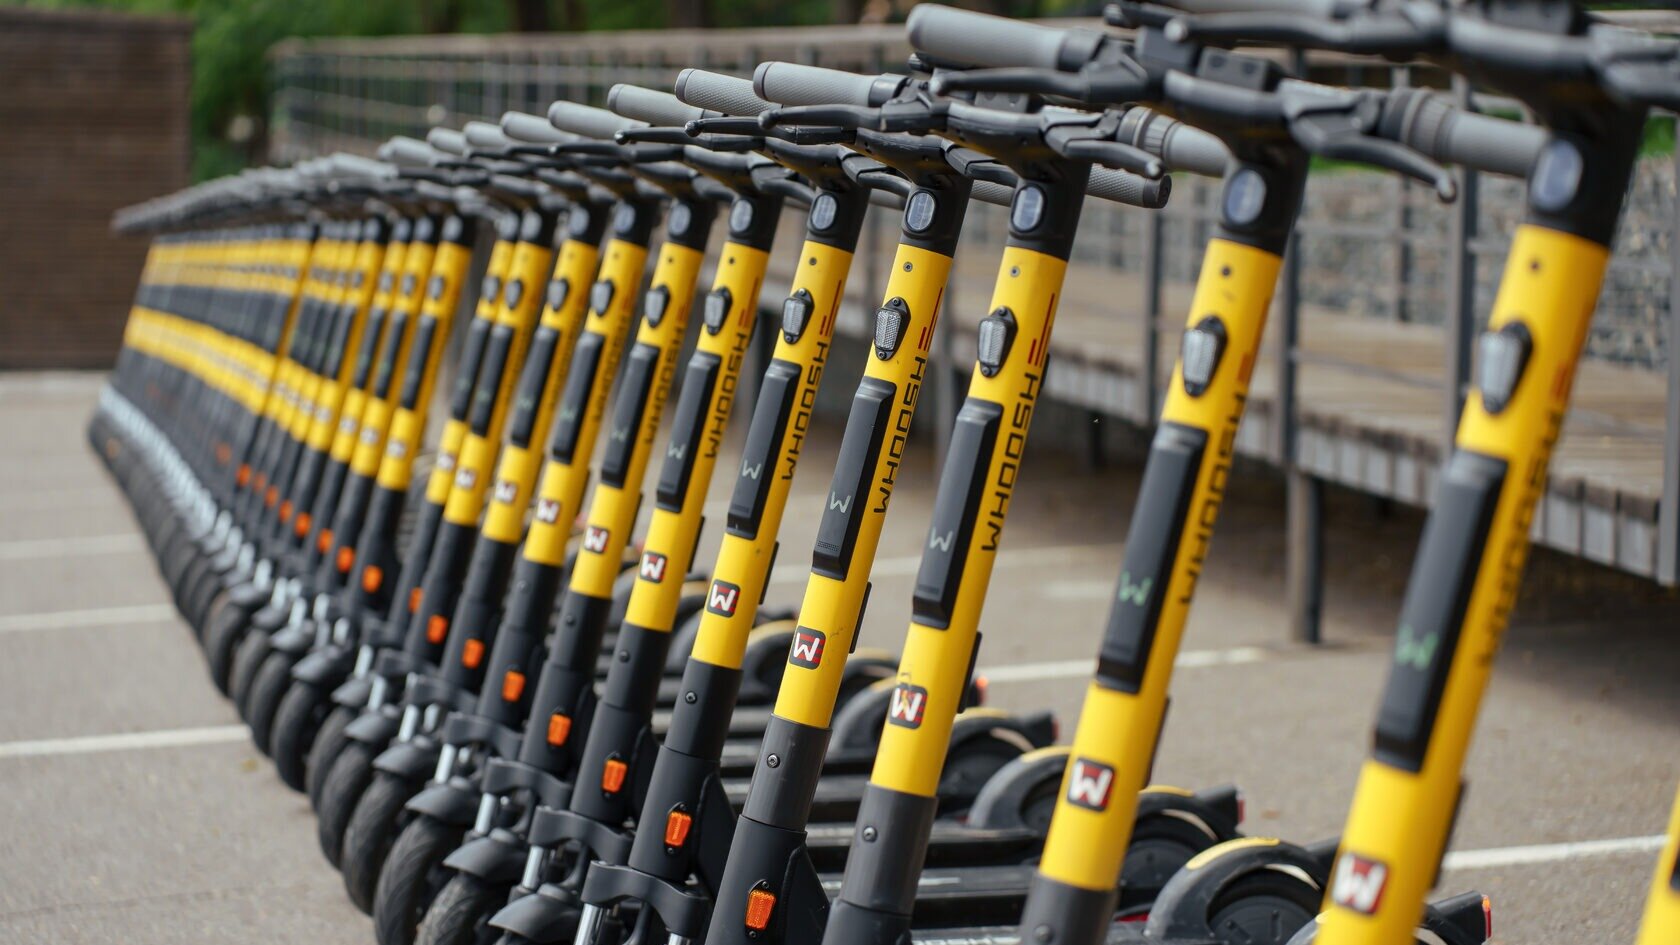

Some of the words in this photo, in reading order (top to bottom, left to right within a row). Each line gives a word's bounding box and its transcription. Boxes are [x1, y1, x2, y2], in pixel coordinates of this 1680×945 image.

[705, 331, 748, 459] WHOOSH
[782, 342, 828, 480] WHOOSH
[873, 355, 926, 513] WHOOSH
[668, 441, 687, 460] W
[981, 373, 1039, 551] WHOOSH
[742, 459, 761, 480] W
[830, 491, 851, 514] W
[586, 528, 607, 551] W
[929, 526, 953, 552] W
[642, 553, 665, 579] W
[711, 584, 735, 611] W
[793, 632, 820, 662] W
[891, 687, 922, 722] W
[1071, 759, 1112, 804] W
